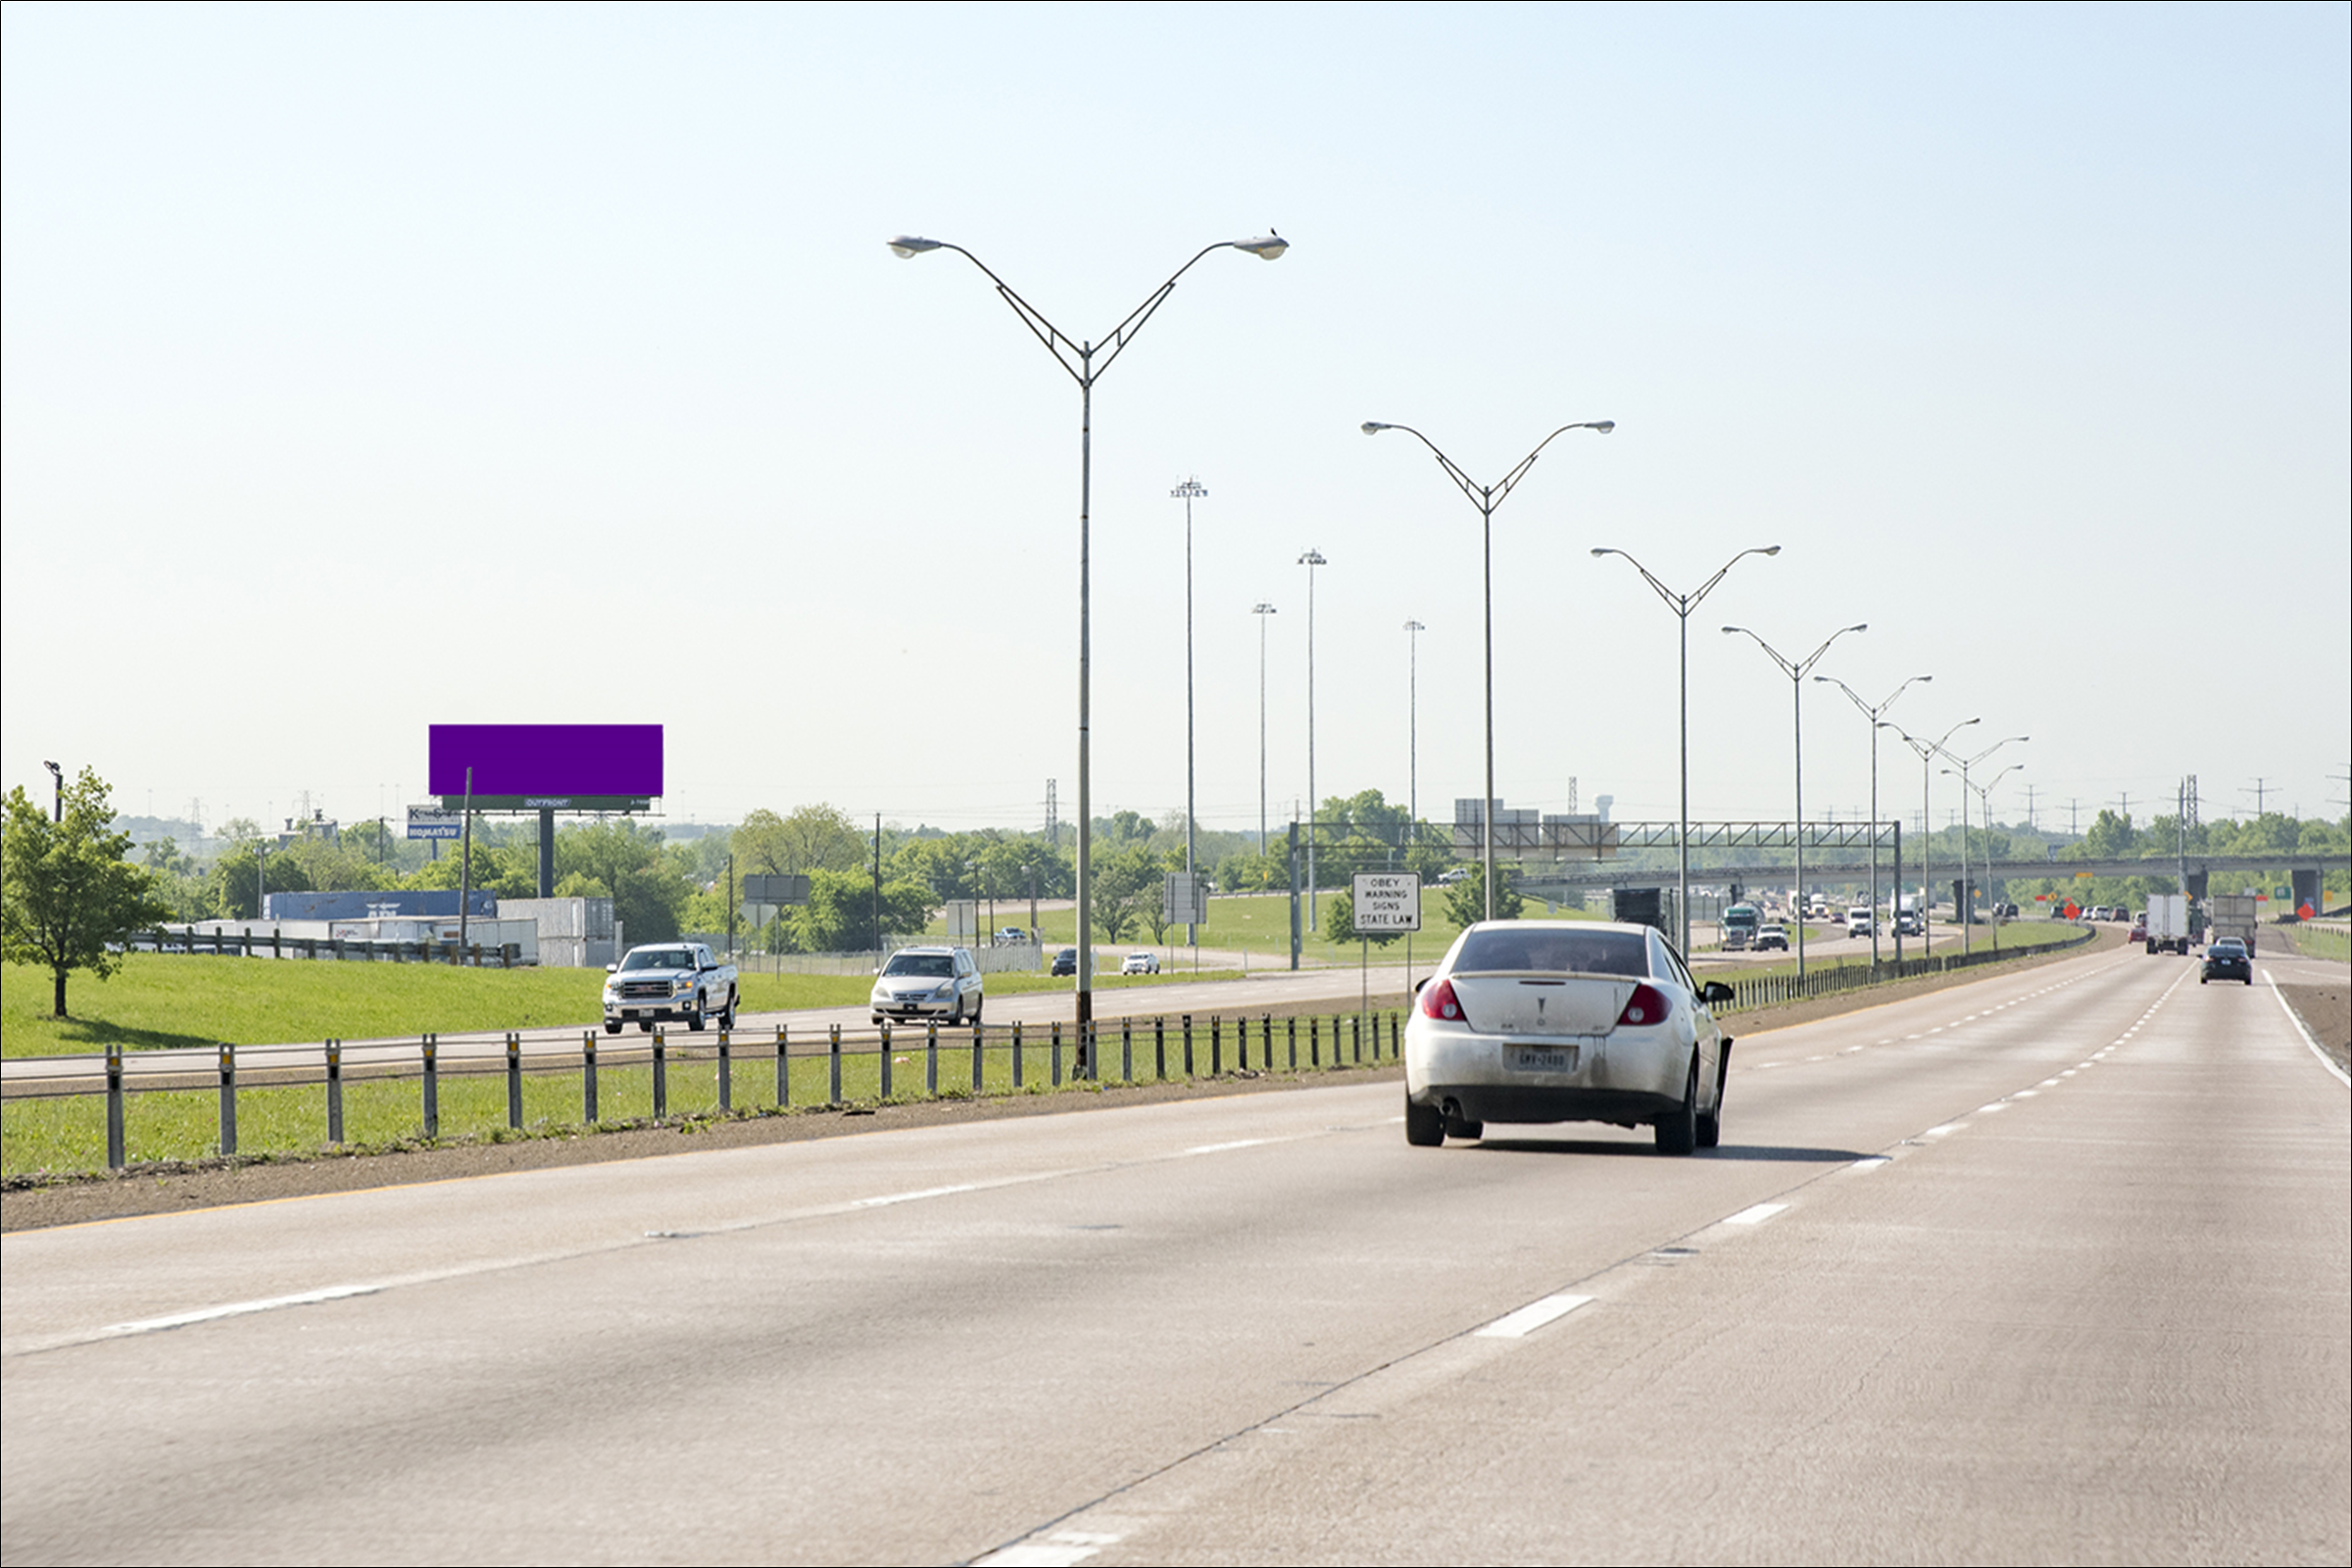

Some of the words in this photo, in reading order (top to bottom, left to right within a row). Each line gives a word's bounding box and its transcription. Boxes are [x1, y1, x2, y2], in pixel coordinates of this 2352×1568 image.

[409, 826, 457, 838] KOMATSU
[1371, 878, 1399, 887] OBEY
[1365, 890, 1407, 899] WARNING
[1373, 902, 1399, 910] SIGNS
[1360, 913, 1389, 924] STATE
[1393, 913, 1413, 924] LAW
